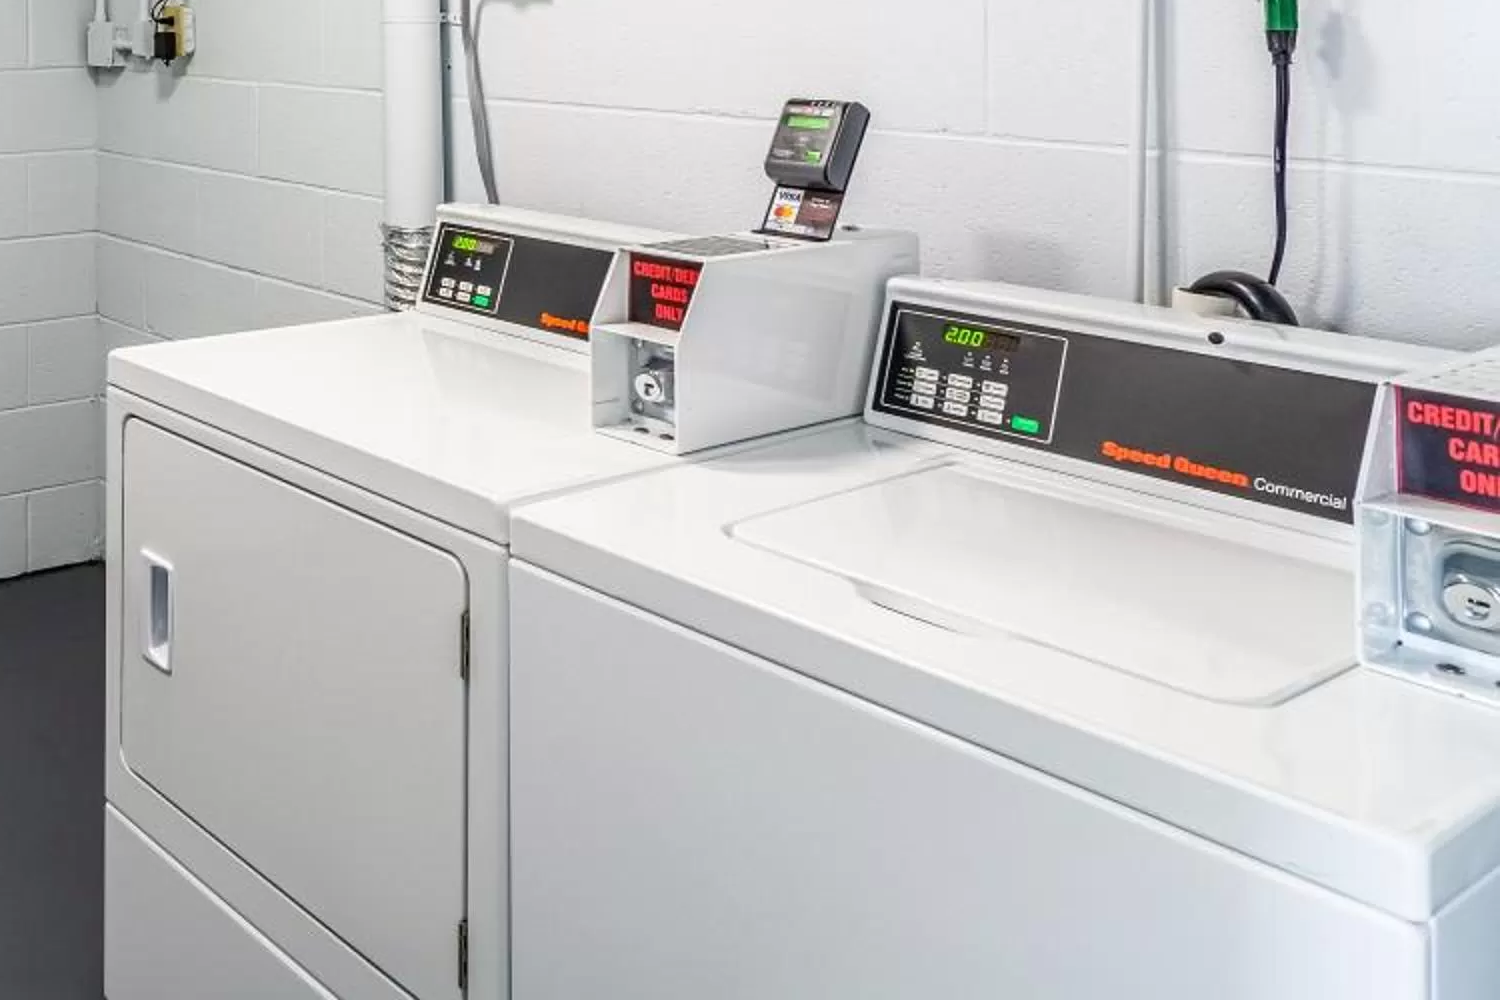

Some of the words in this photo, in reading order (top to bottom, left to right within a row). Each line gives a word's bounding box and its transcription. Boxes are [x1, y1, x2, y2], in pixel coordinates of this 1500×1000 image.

[651, 283, 688, 304] CARDS
[655, 303, 683, 321] ONLY
[1407, 400, 1500, 441] CREDIT/
[1448, 437, 1500, 469] CAR
[1101, 440, 1172, 470] Speed
[1174, 456, 1250, 488] Queen
[1253, 477, 1348, 510] Commercial
